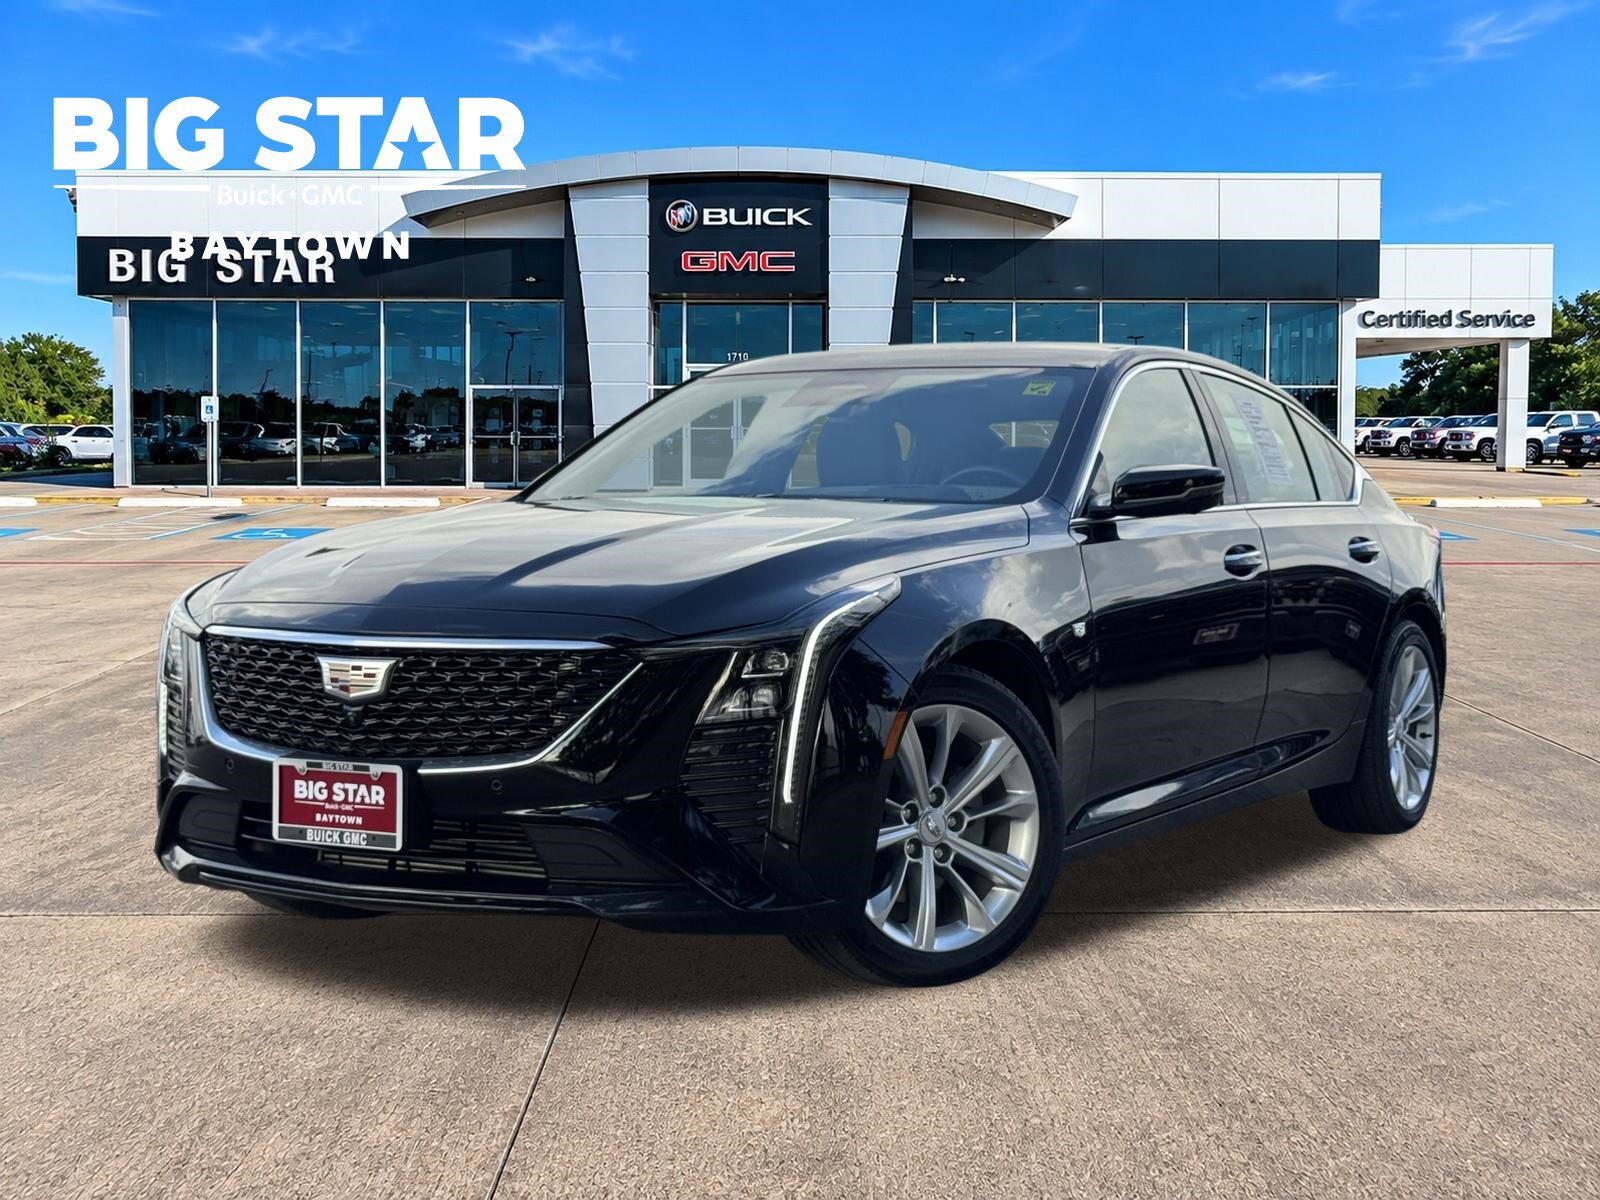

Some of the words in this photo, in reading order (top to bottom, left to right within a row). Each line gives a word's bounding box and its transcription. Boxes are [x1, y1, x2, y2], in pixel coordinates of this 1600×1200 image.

[702, 208, 813, 226] BUICK
[108, 248, 188, 283] BIG
[216, 248, 336, 283] STAR
[681, 250, 796, 272] GMC
[1358, 309, 1453, 329] Certified
[1455, 309, 1536, 329] Service
[727, 351, 749, 361] 1710
[294, 779, 328, 801] BIG
[332, 781, 385, 805] STAR
[315, 813, 363, 825] BAYTOWN
[306, 829, 340, 843] BUICK
[343, 832, 367, 845] GMC
